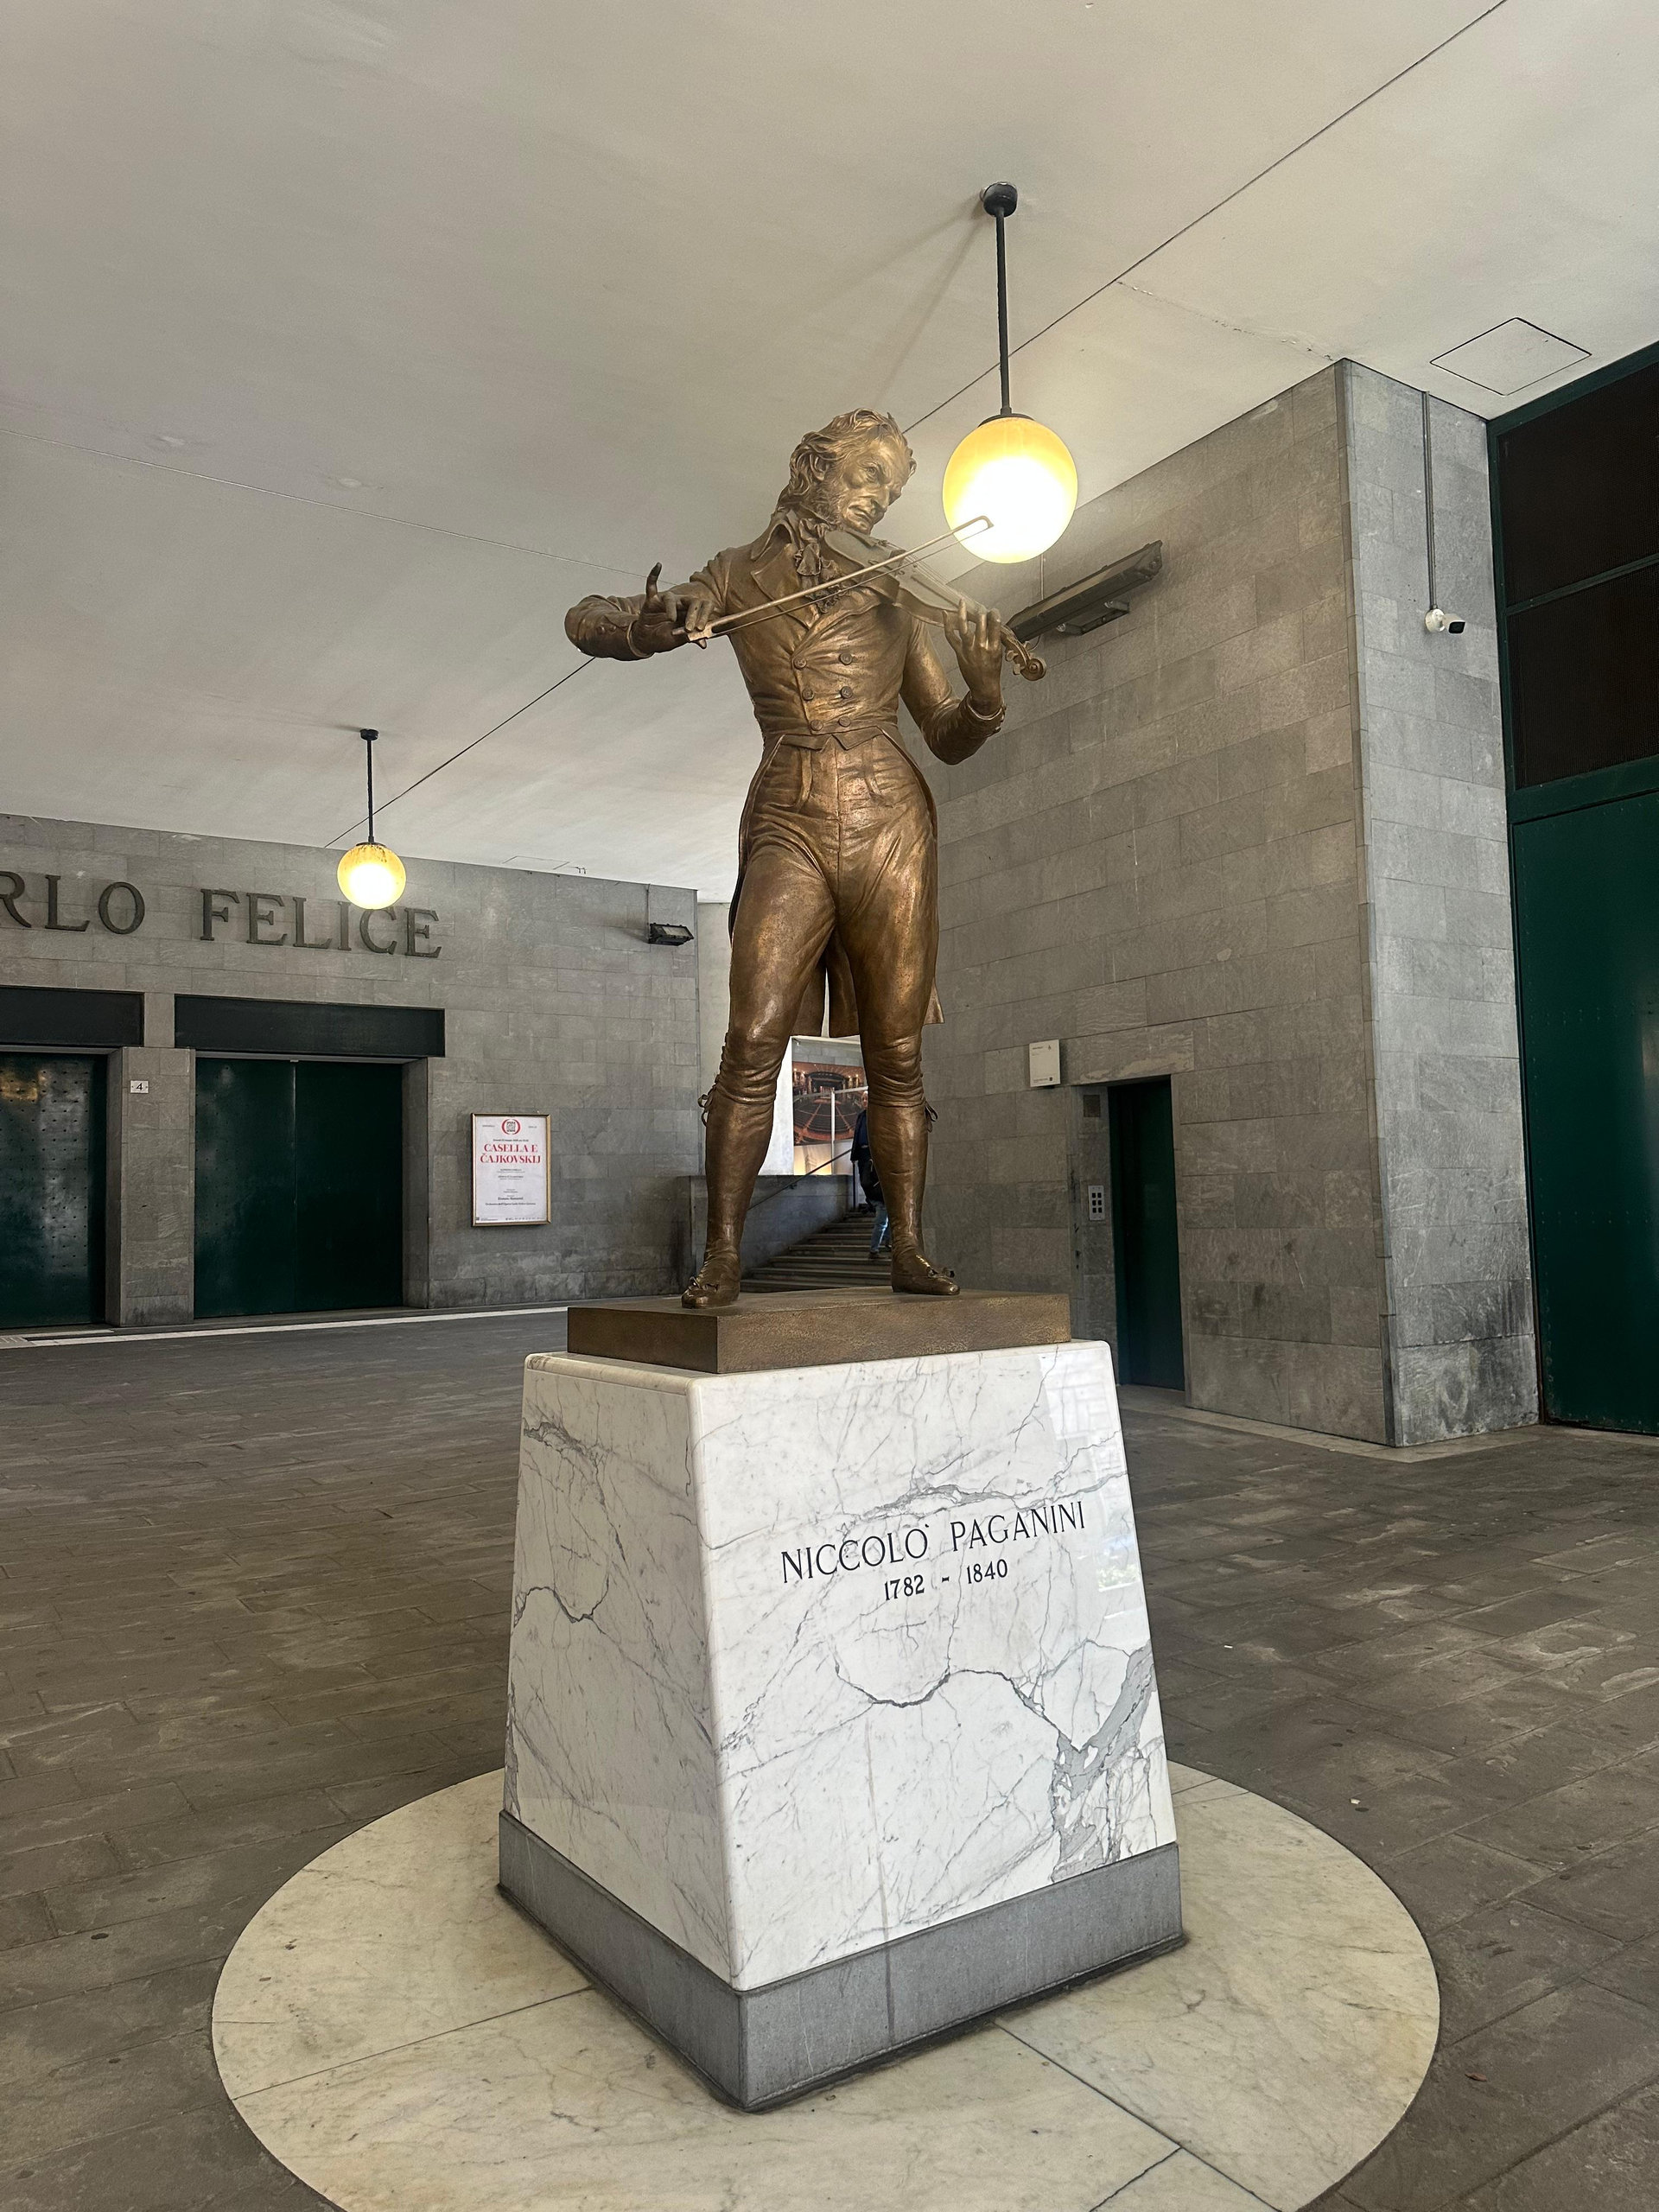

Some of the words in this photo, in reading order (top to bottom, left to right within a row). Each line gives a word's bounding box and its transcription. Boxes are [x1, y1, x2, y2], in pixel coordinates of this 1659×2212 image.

[200, 888, 442, 959] FELICE
[480, 1153, 541, 1164] ČAJKOVSKIJ
[484, 1143, 529, 1153] CASELLA
[531, 1144, 538, 1153] E
[950, 1501, 1085, 1553] PAGANINI
[884, 1574, 925, 1601] 1782
[966, 1559, 1008, 1585] 1840
